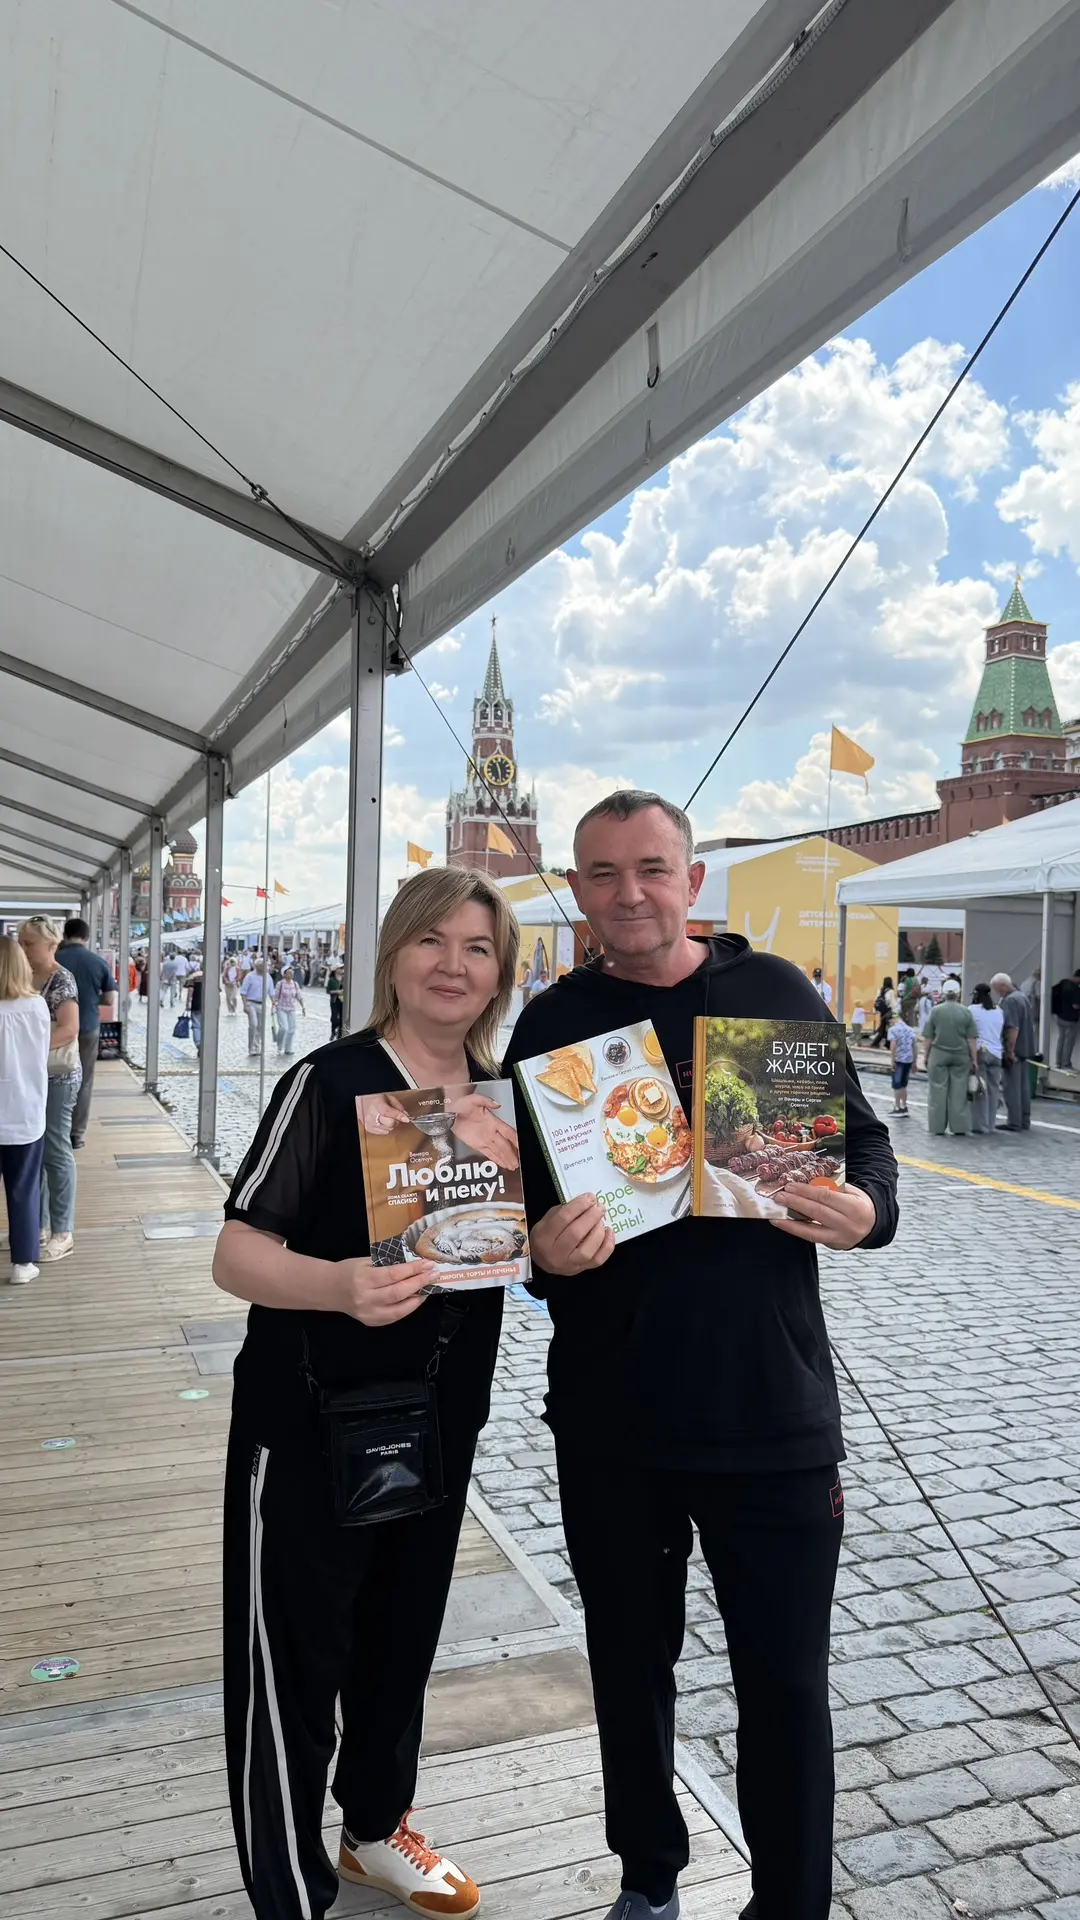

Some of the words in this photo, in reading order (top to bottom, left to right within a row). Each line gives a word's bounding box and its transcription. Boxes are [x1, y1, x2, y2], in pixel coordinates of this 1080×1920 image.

[772, 1041, 829, 1059] БУДЕТ
[765, 1058, 835, 1076] ЖАРКО!
[551, 1128, 564, 1138] 100
[573, 1118, 596, 1131] рецепт
[555, 1137, 567, 1146] для
[567, 1129, 593, 1141] вкусных
[557, 1138, 589, 1154] завтраков
[386, 1155, 498, 1190] Люблю
[426, 1188, 439, 1202] и
[444, 1175, 506, 1201] пеку!
[596, 1184, 634, 1206] брое
[387, 1197, 418, 1206] СПАСИБО
[605, 1203, 632, 1223] ро,
[611, 1208, 645, 1234] аны!
[466, 1270, 486, 1278] ТОРТЫ
[492, 1267, 517, 1275] ПЕЧЕНЬЕ
